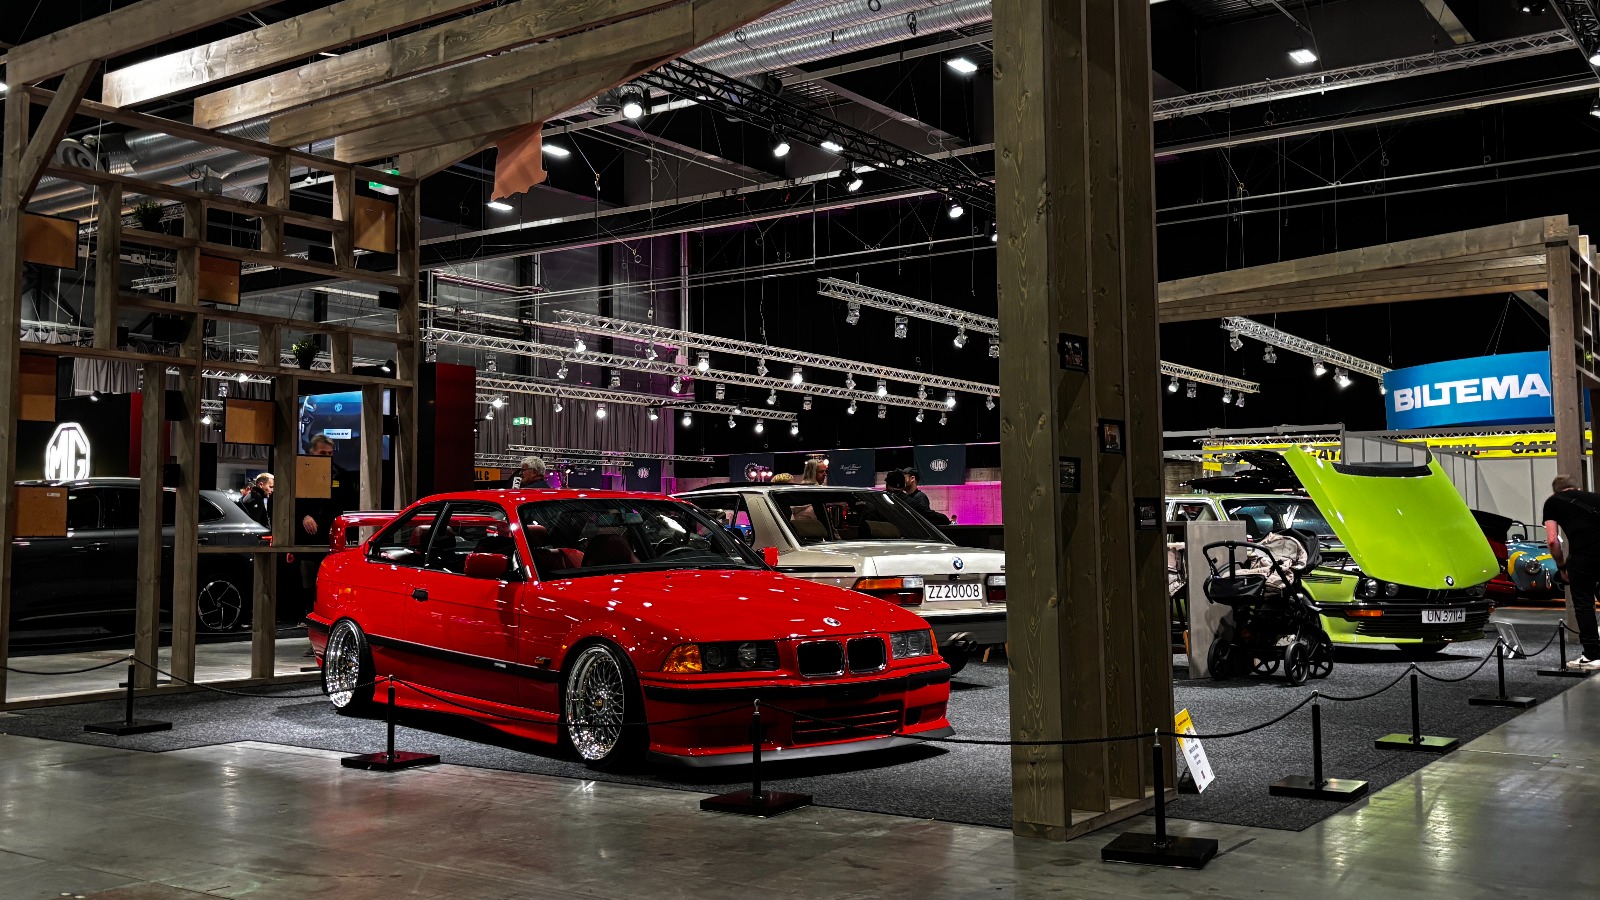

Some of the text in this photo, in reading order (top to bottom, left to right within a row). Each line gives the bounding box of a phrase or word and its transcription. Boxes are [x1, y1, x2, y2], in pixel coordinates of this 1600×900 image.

[1393, 373, 1550, 412] BILTEMA
[47, 425, 89, 480] MG
[928, 584, 980, 599] ZZ 20008
